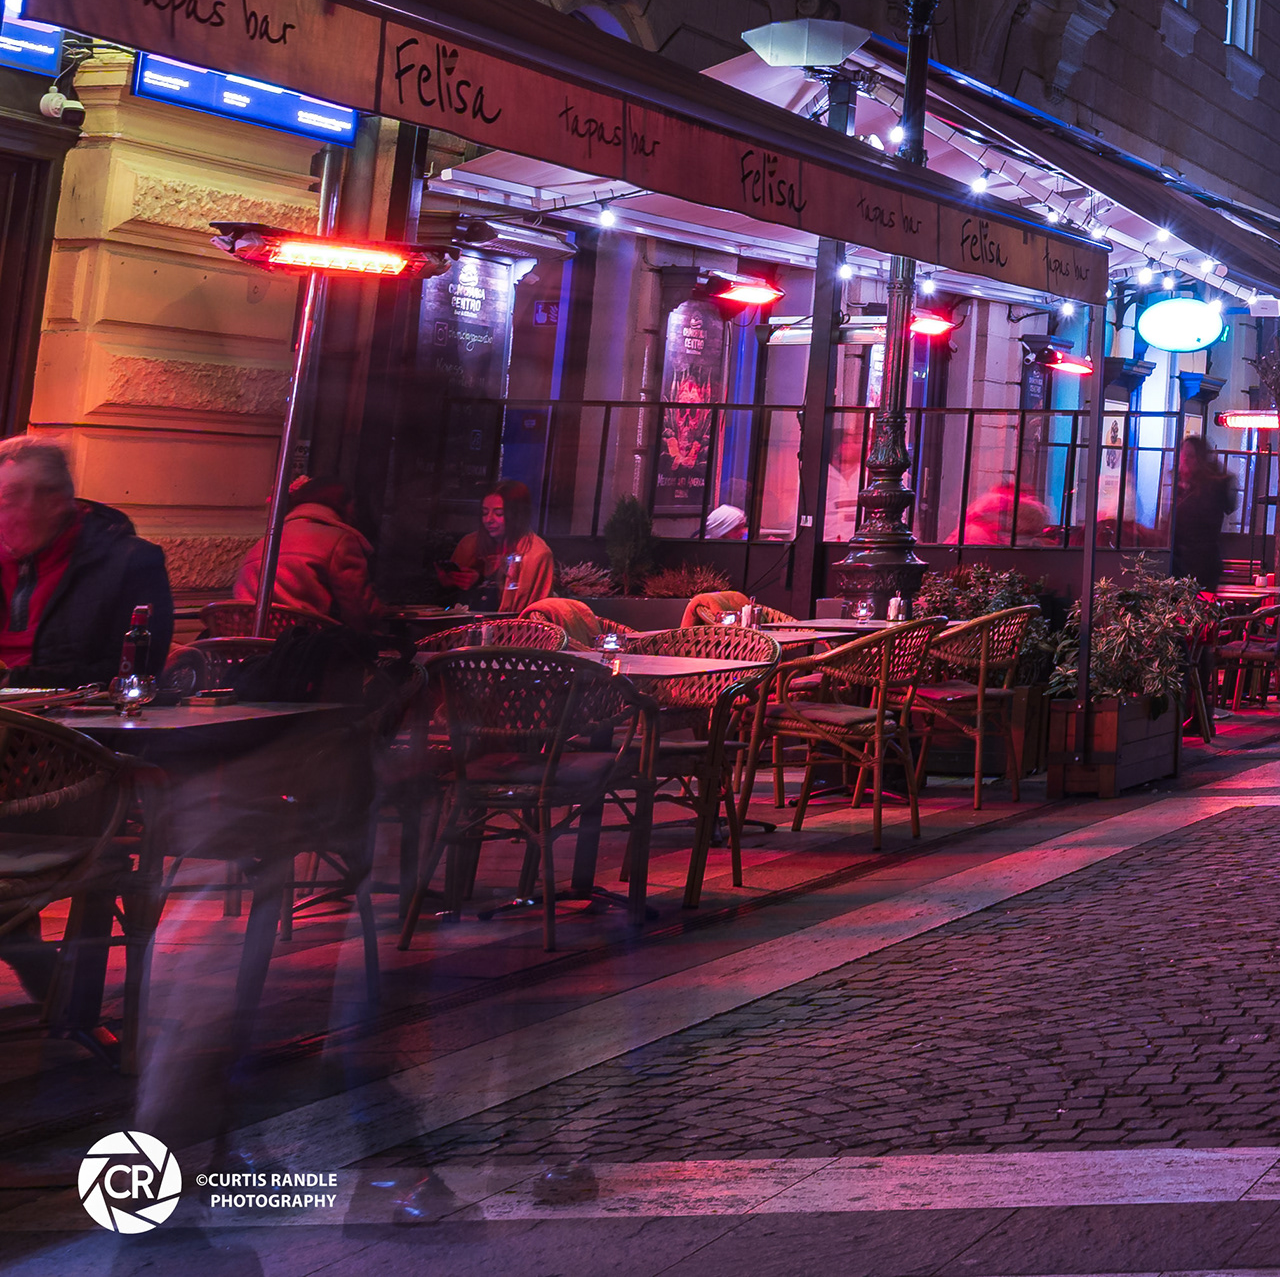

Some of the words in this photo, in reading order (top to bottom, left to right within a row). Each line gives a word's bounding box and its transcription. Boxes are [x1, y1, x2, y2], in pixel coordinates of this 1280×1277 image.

[394, 37, 502, 125] Felisa
[558, 95, 622, 158] tapas
[627, 102, 661, 158] bar
[740, 150, 807, 214] Felisa
[856, 196, 896, 235] tapas
[901, 207, 922, 235] bar
[960, 218, 1008, 267] Felisa
[1042, 250, 1075, 288] tapas
[1076, 255, 1091, 282] bar
